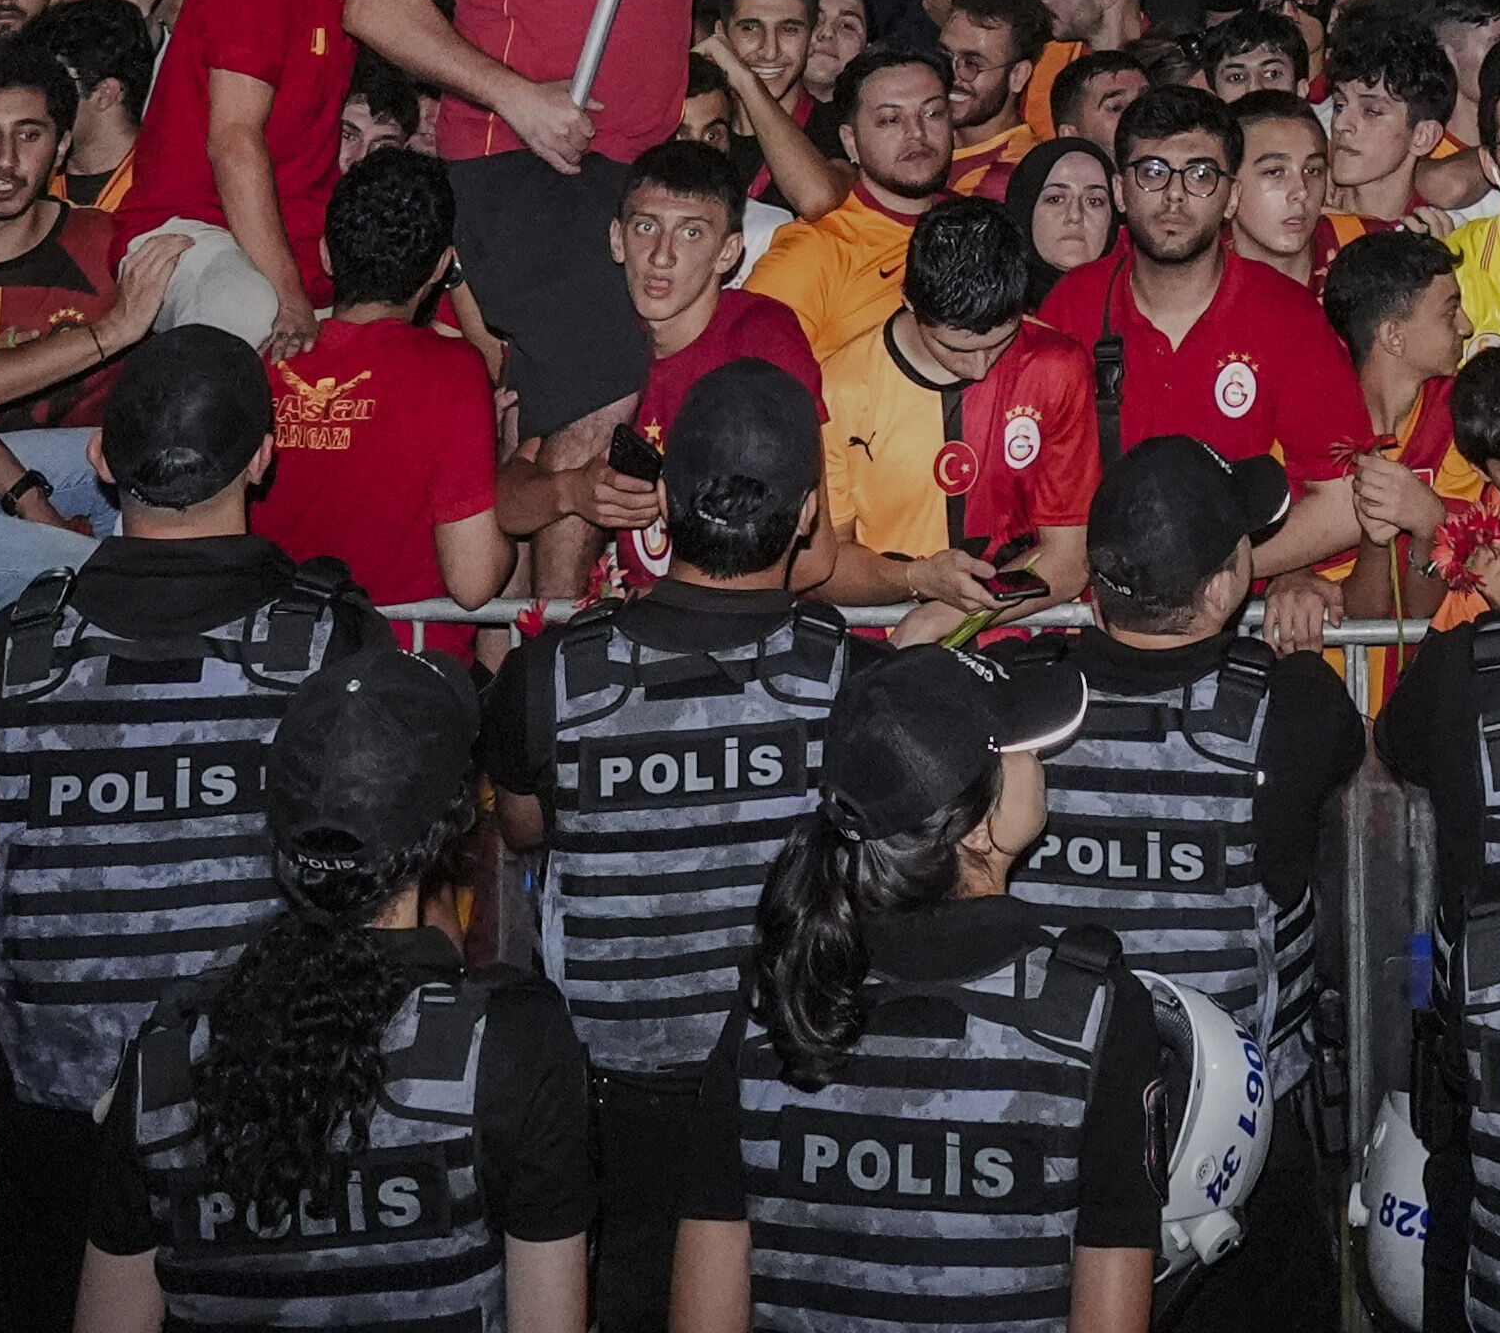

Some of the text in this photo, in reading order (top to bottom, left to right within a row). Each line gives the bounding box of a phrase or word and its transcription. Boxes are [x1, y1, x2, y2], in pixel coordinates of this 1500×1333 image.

[48, 756, 239, 817] POLİS
[599, 736, 784, 798] POLİS
[1030, 830, 1205, 882] POLİS
[802, 1131, 1015, 1199] POLİS
[198, 1169, 422, 1242] POLİS
